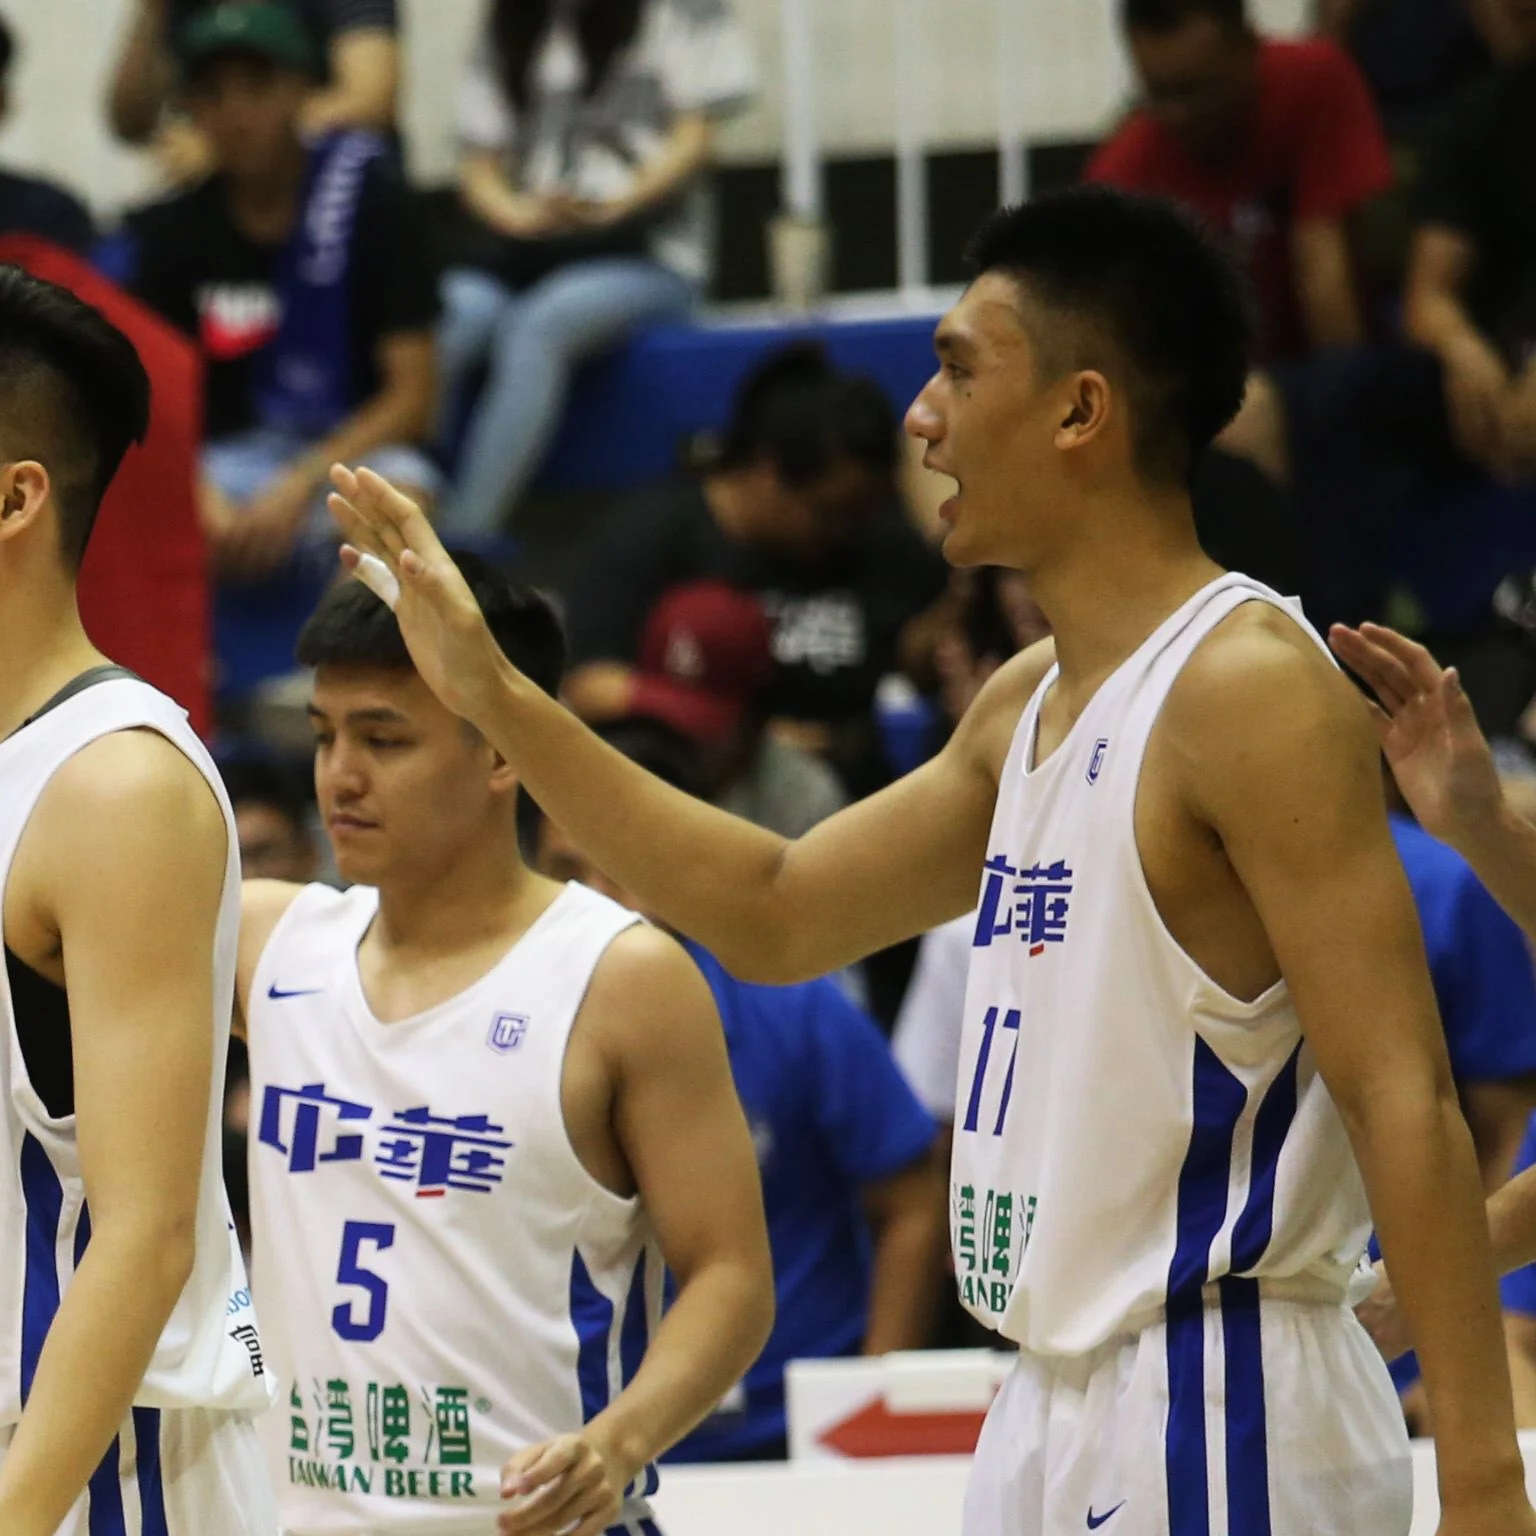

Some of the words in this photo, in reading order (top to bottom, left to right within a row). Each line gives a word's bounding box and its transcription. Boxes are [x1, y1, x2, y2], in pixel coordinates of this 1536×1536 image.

[962, 1006, 1022, 1137] 17
[259, 1083, 515, 1198] 中華
[331, 1220, 395, 1342] 5
[288, 1455, 373, 1494] TAIWAN
[384, 1468, 476, 1497] BEER
